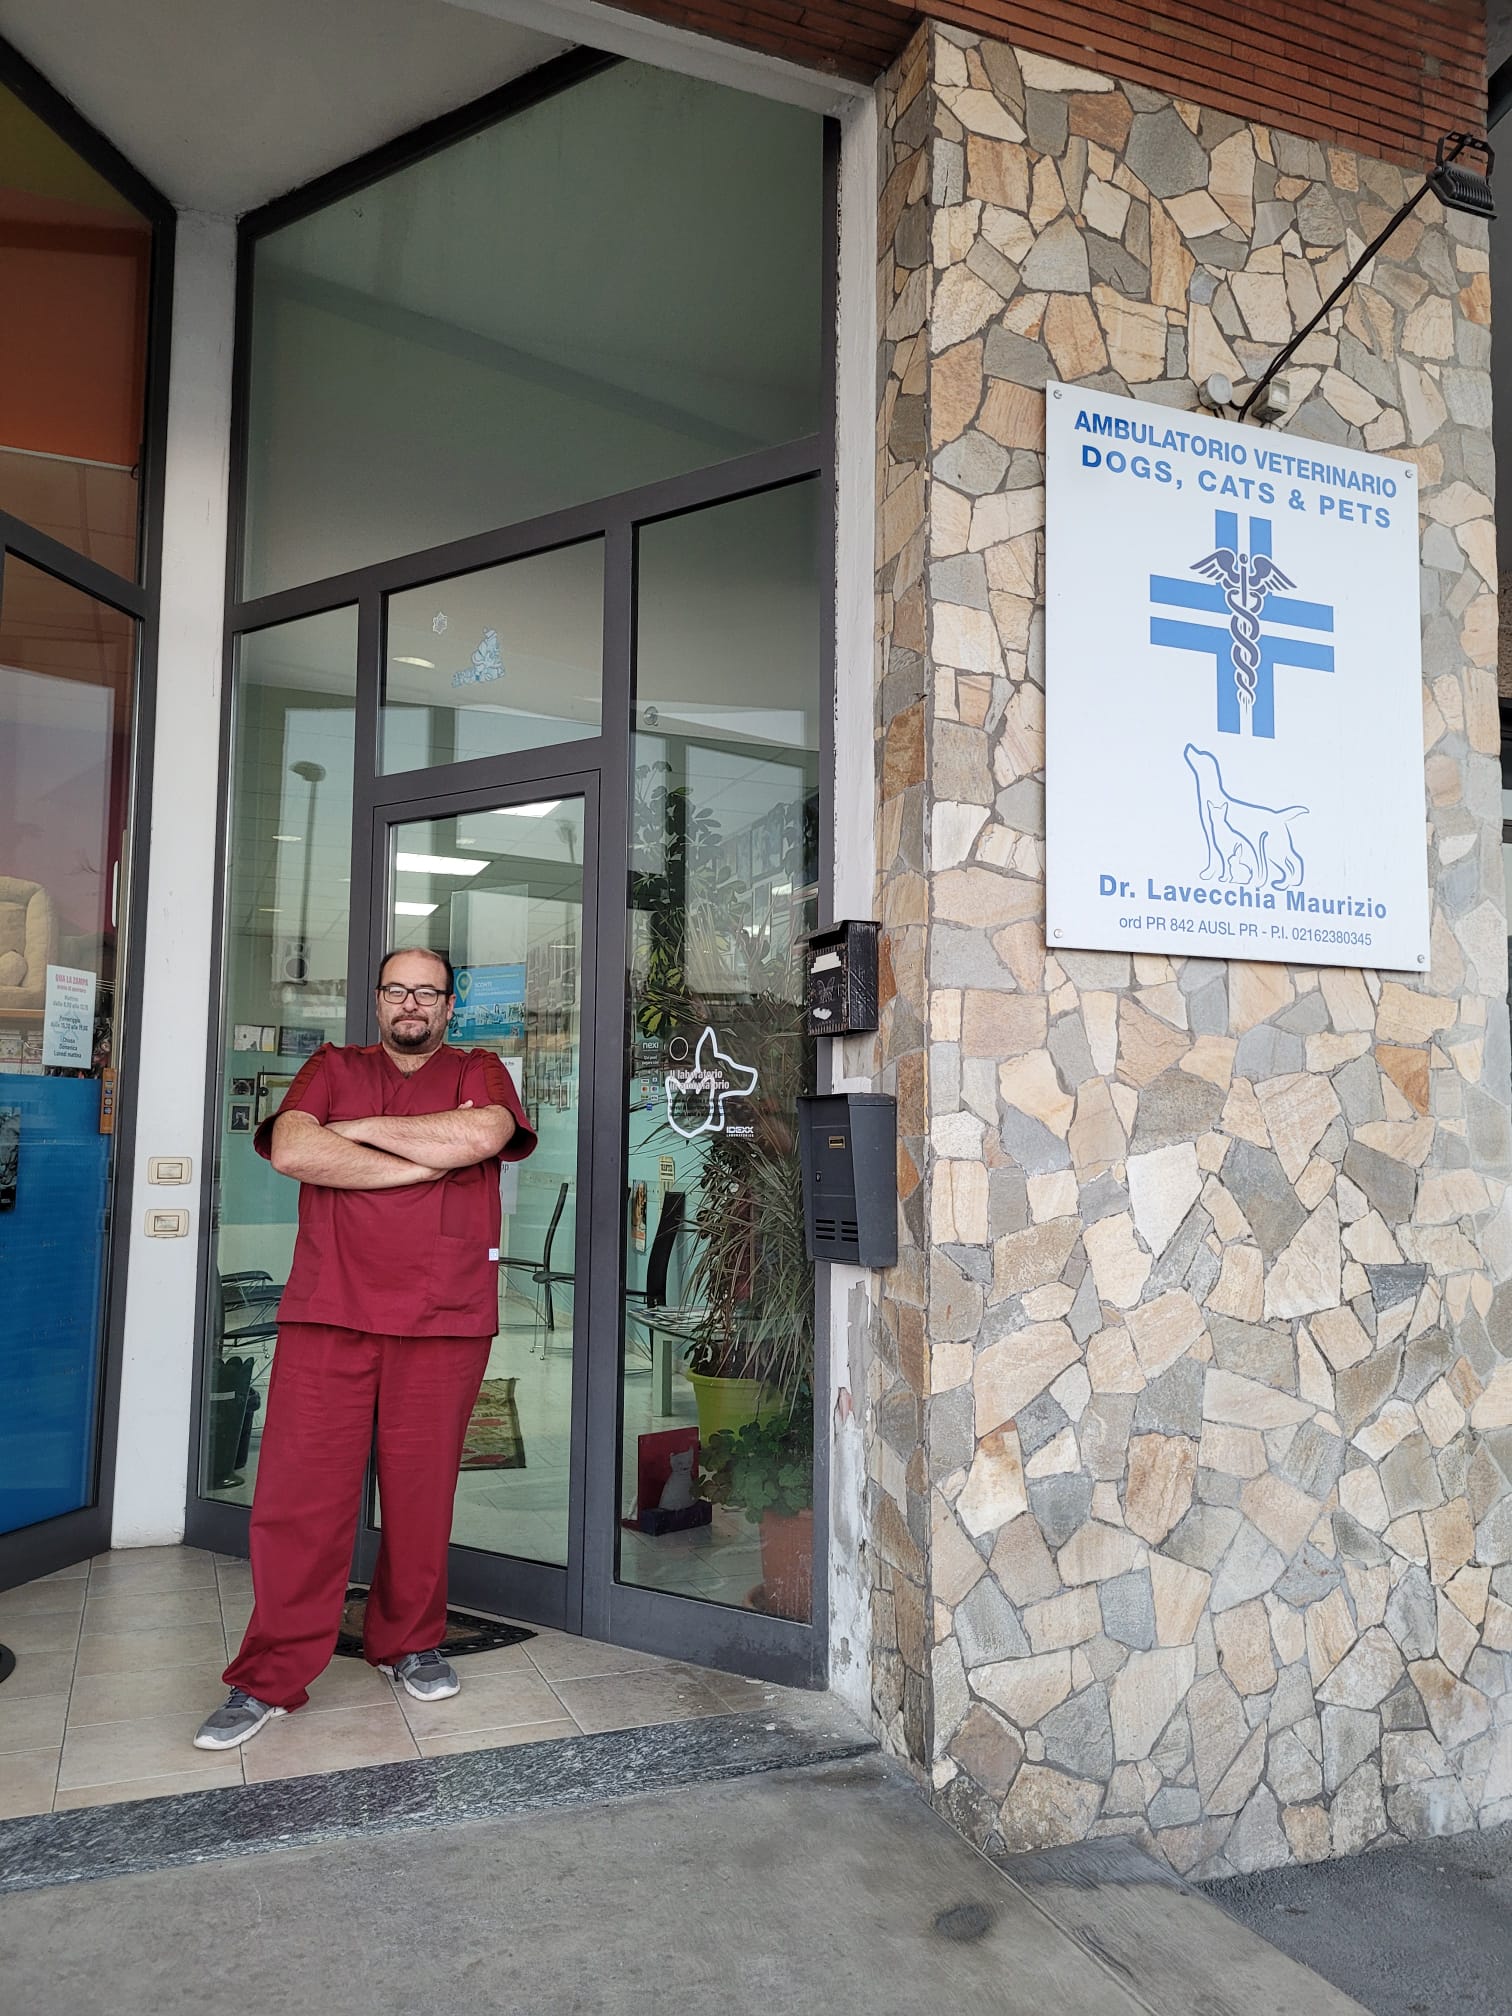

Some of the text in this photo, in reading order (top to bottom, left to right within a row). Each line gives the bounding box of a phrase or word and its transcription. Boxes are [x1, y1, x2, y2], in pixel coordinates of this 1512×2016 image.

[1074, 410, 1397, 498] AMBULATORIO VETERINARIO
[1081, 445, 1391, 529] DOGS, CATS & PETS
[1099, 874, 1387, 919] Dr. Lavecchia Maurizio
[1119, 915, 1142, 930] ord
[1146, 917, 1167, 932] PR
[1170, 918, 1194, 934] 842
[1198, 920, 1235, 936] AUSL
[1239, 922, 1259, 938] PR
[1270, 925, 1289, 940] P.I.
[1291, 926, 1373, 947] 02162380345
[678, 1069, 723, 1080] laboratorio
[726, 1126, 754, 1134] IDEXX
